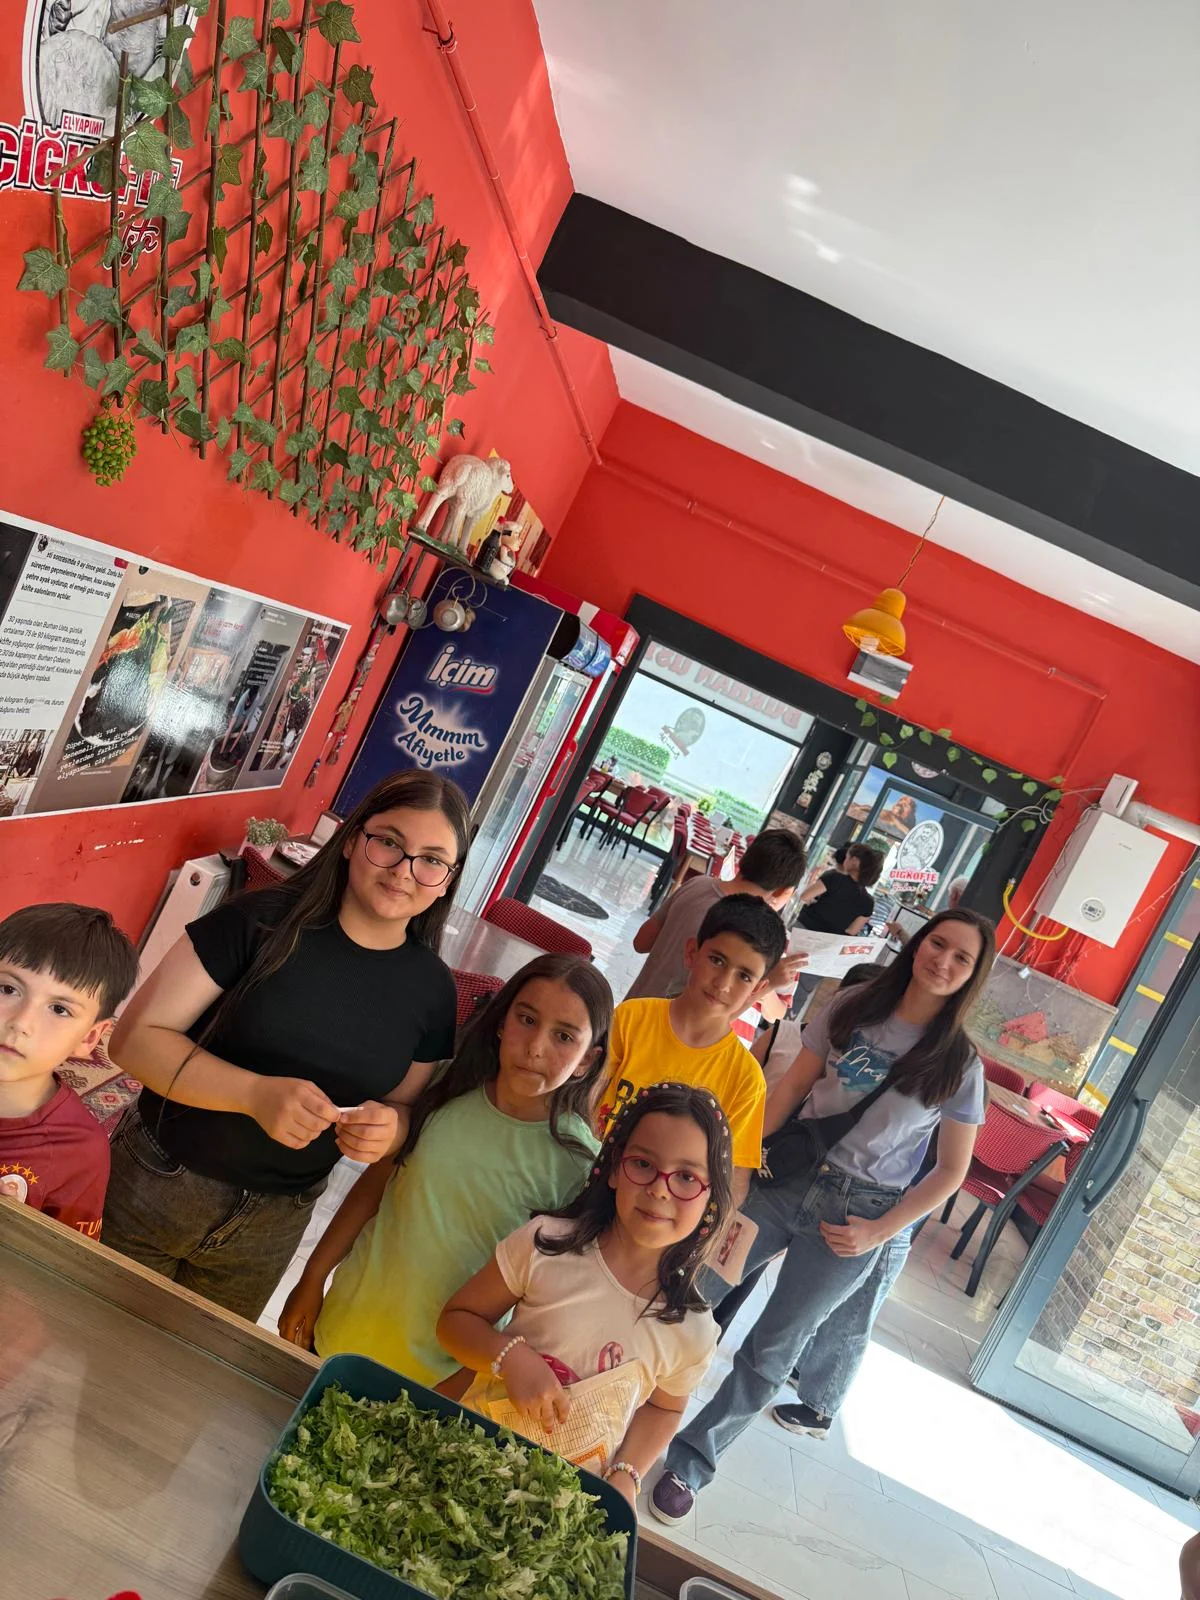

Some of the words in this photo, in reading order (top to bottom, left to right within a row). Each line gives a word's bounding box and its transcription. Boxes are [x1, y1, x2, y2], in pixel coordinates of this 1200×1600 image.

[428, 645, 496, 688] İçim
[400, 696, 485, 747] Mmmm
[397, 730, 465, 768] Afiyetle
